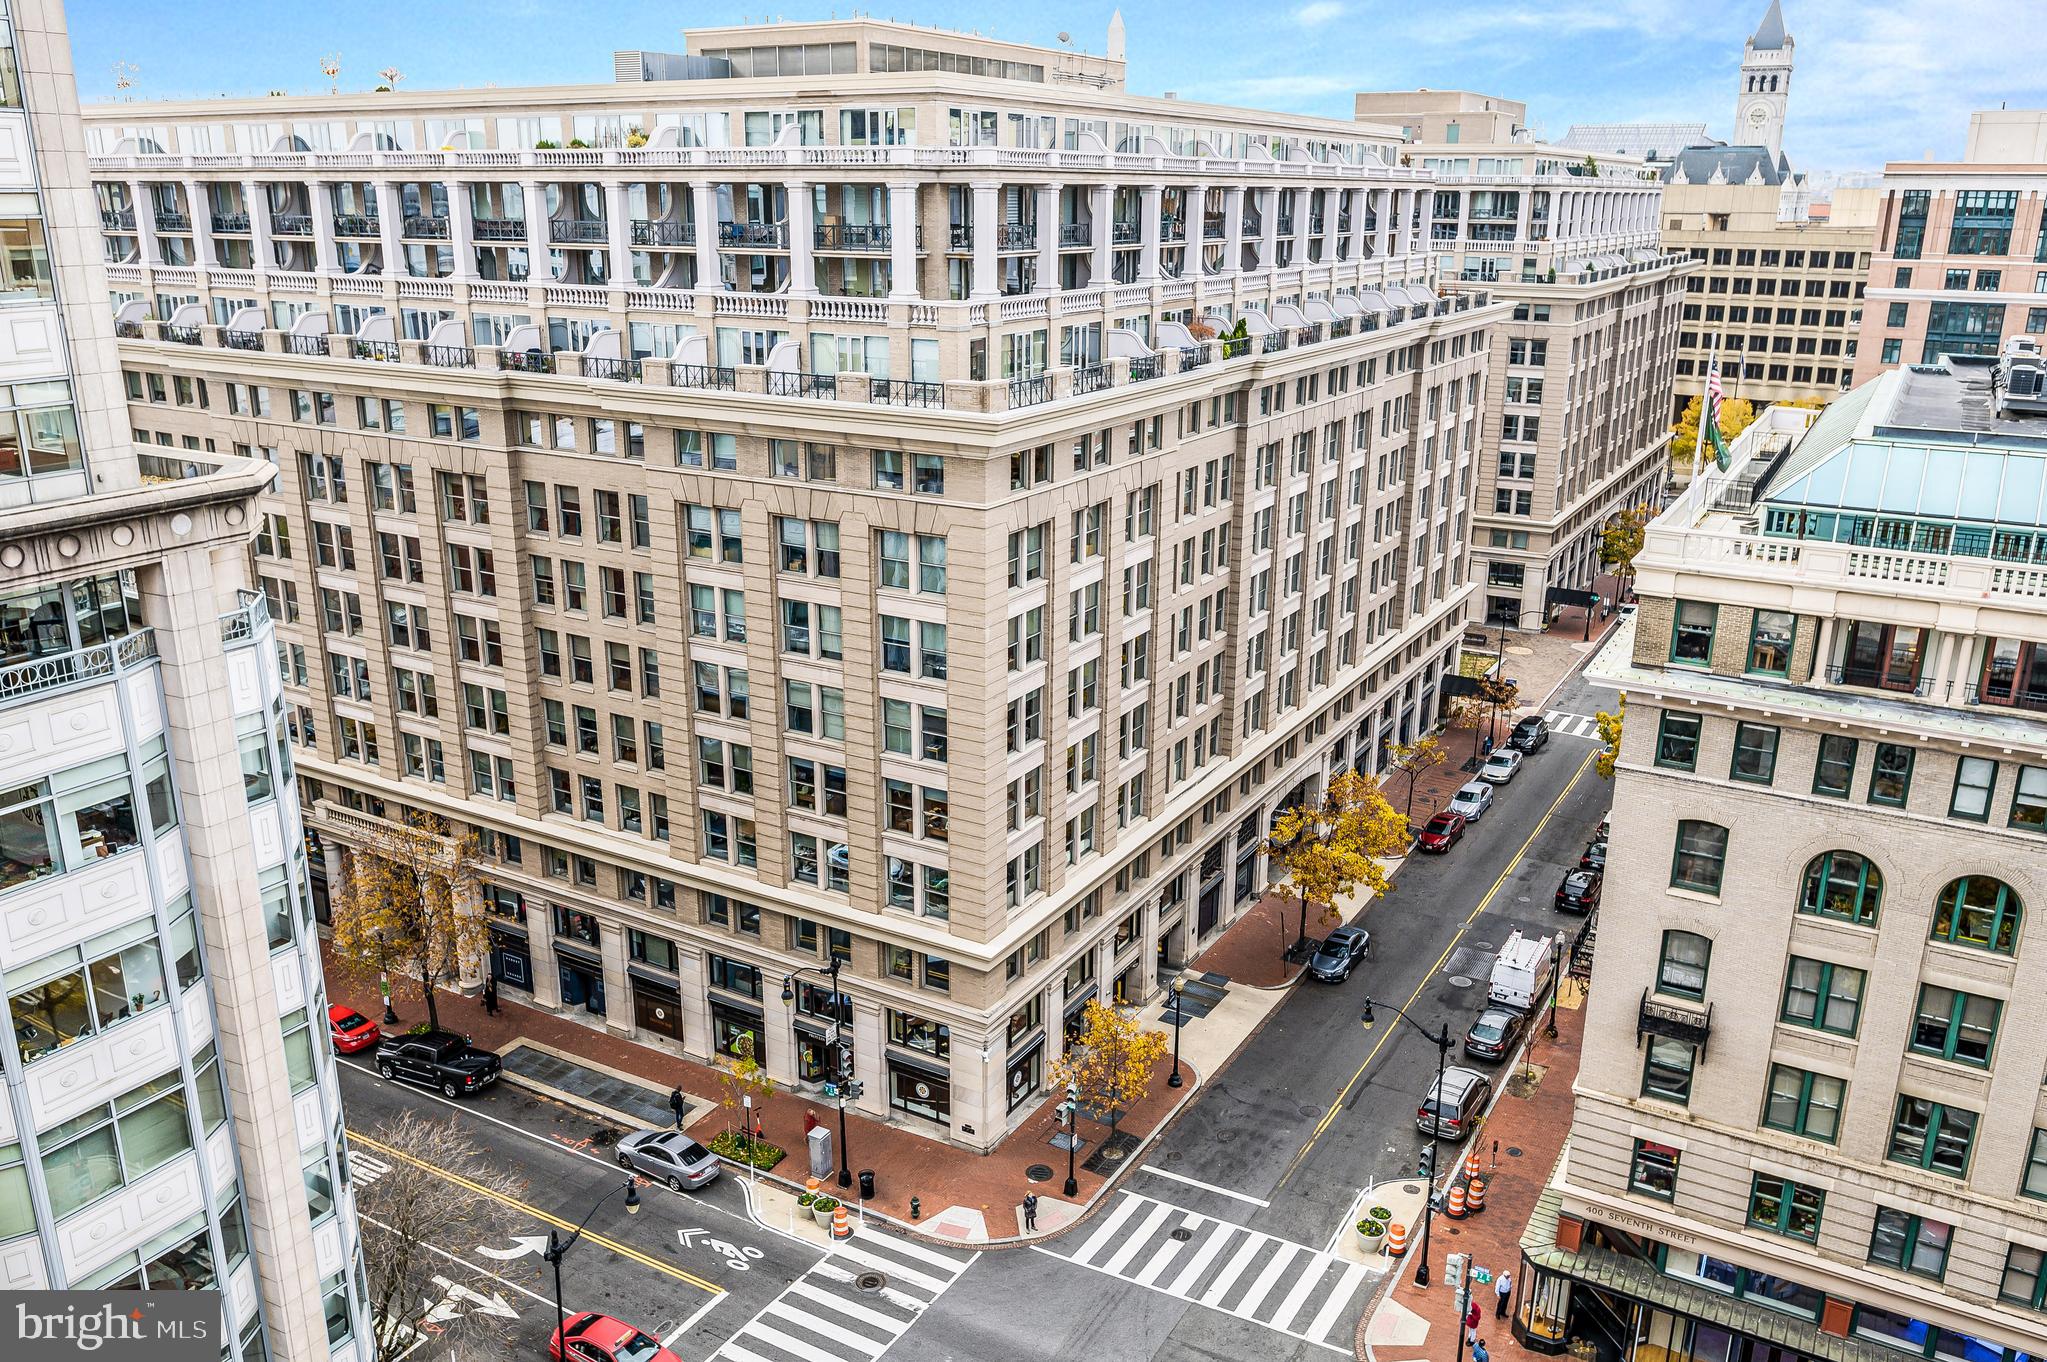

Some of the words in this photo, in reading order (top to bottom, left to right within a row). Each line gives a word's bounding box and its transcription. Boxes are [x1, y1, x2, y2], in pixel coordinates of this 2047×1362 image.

[1586, 1206, 1604, 1217] 400
[1608, 1213, 1653, 1232] SEVENTH
[1658, 1228, 1697, 1245] STREET
